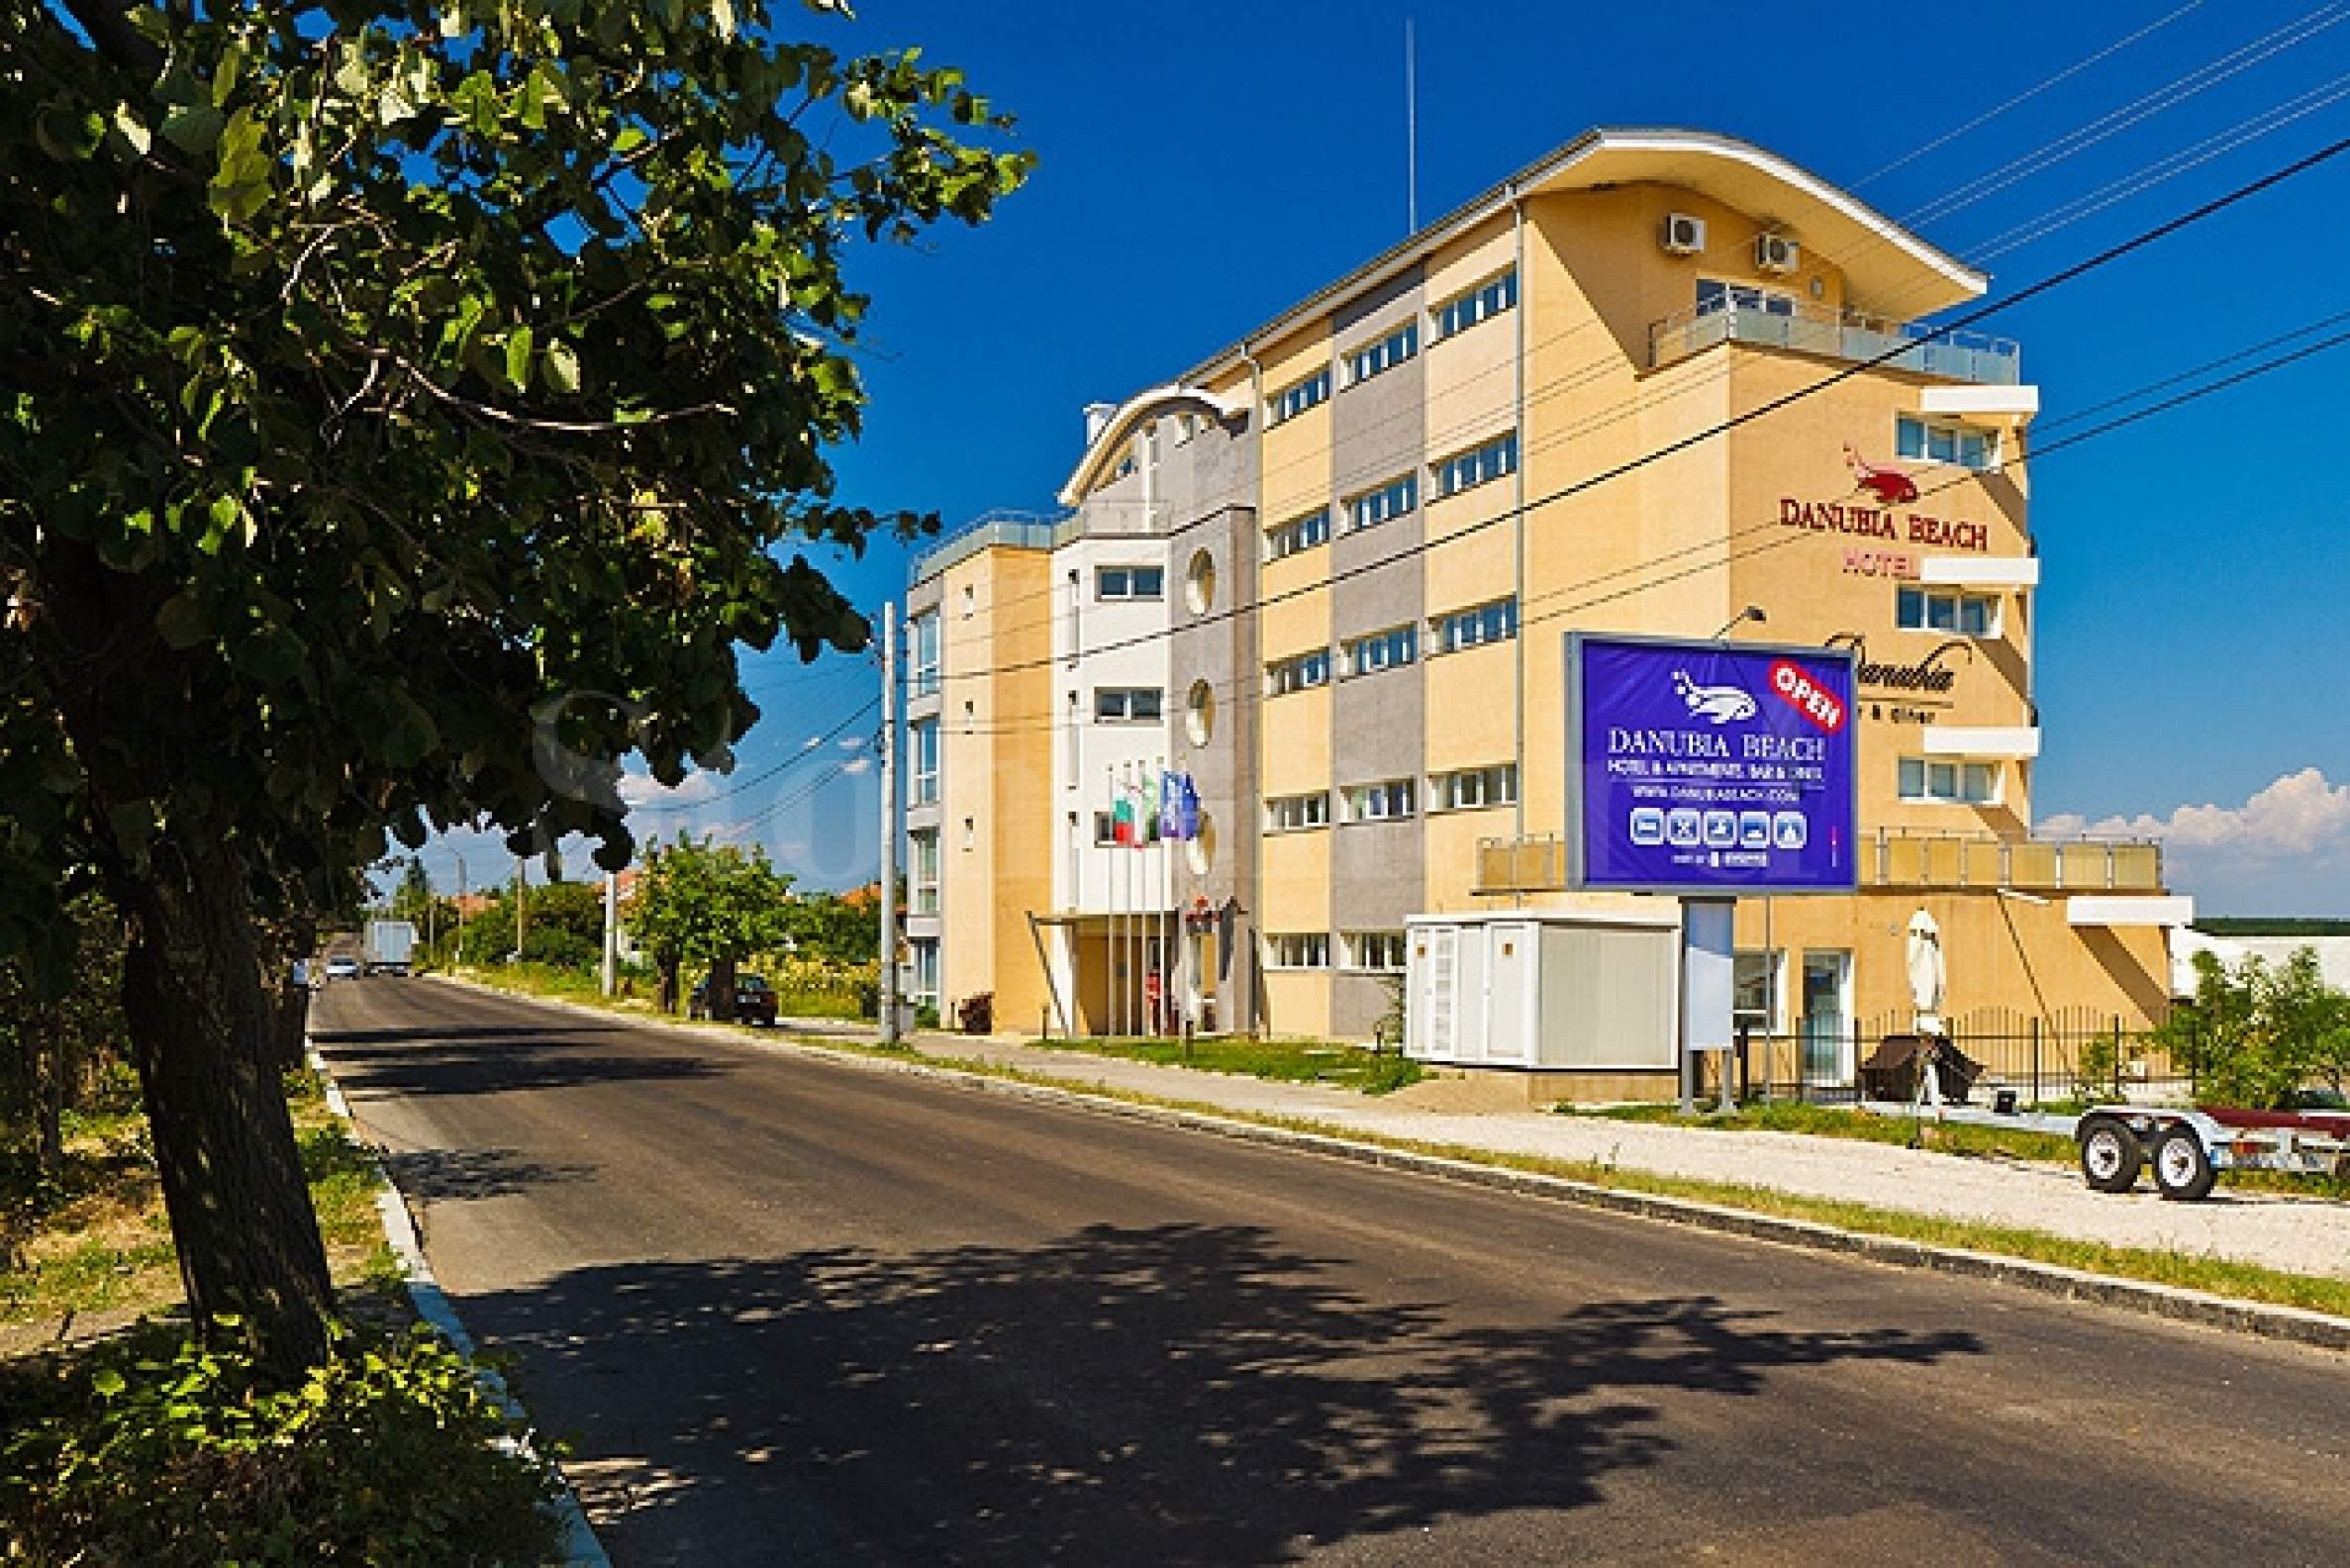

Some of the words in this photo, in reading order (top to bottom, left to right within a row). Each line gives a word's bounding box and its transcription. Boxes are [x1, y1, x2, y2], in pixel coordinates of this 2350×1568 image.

[1780, 499, 1897, 540] DANUBIA
[1909, 514, 1989, 551] BEACH
[1843, 548, 1920, 579] HOTEL
[1775, 665, 1841, 729] OPEN
[1608, 727, 1730, 758] DANUBIA
[1742, 734, 1826, 761] BEACH
